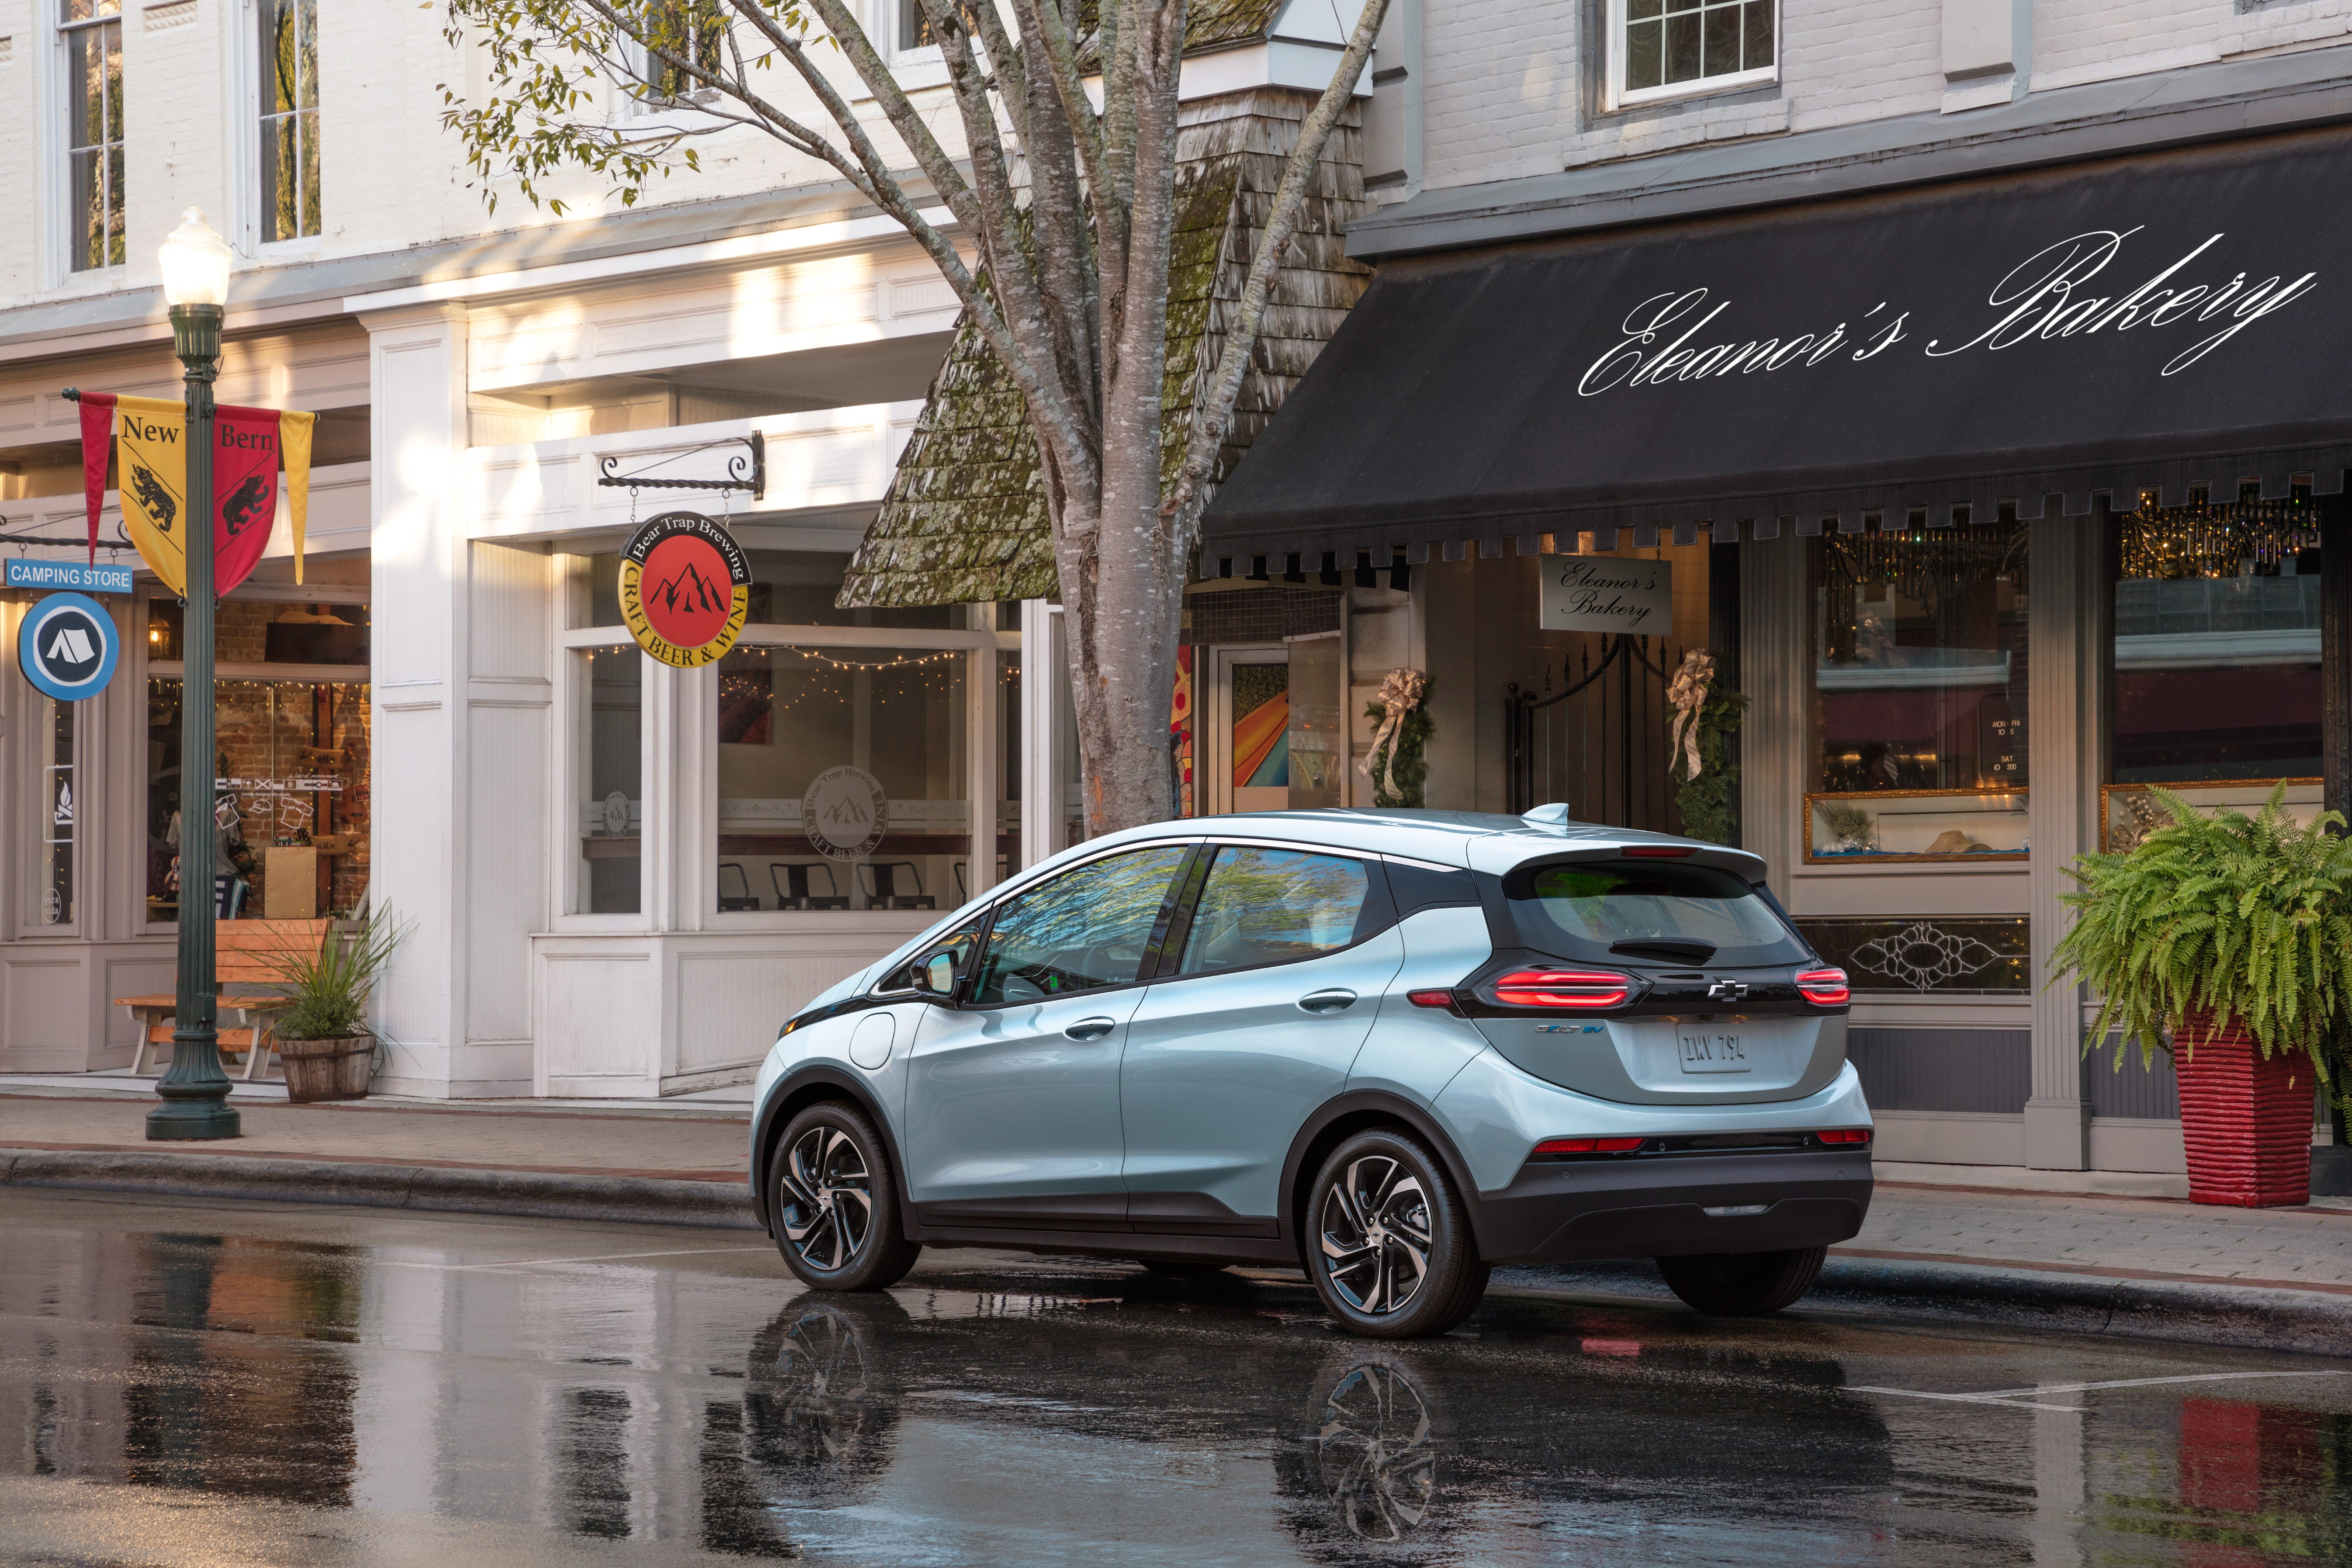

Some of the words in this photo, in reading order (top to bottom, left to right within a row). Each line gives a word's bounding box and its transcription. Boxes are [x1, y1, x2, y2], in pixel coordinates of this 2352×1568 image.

[1578, 287, 1910, 396] Eleanor's
[1925, 225, 2317, 376] Bakery
[122, 415, 179, 443] New
[220, 424, 274, 450] Bern
[633, 526, 660, 560] Bear
[661, 517, 695, 531] Trap
[698, 519, 744, 580] Brewing
[11, 565, 79, 584] CAMPING
[83, 570, 130, 587] STORE
[1561, 562, 1657, 590] Eleanor's
[624, 566, 651, 636] CRAFT
[648, 636, 694, 665] BEER
[701, 646, 716, 662] &
[716, 592, 746, 648] WINE
[1561, 589, 1652, 627] Bakery
[807, 783, 821, 807] Bear
[821, 771, 842, 783] Trap
[845, 768, 876, 793] Brewing
[806, 816, 832, 854] CRAFT
[833, 846, 865, 859] BEER
[866, 838, 876, 848] &
[873, 798, 886, 834] WINE
[45, 897, 59, 905] pura
[45, 906, 58, 914] vida
[1718, 1034, 1745, 1060] 794
